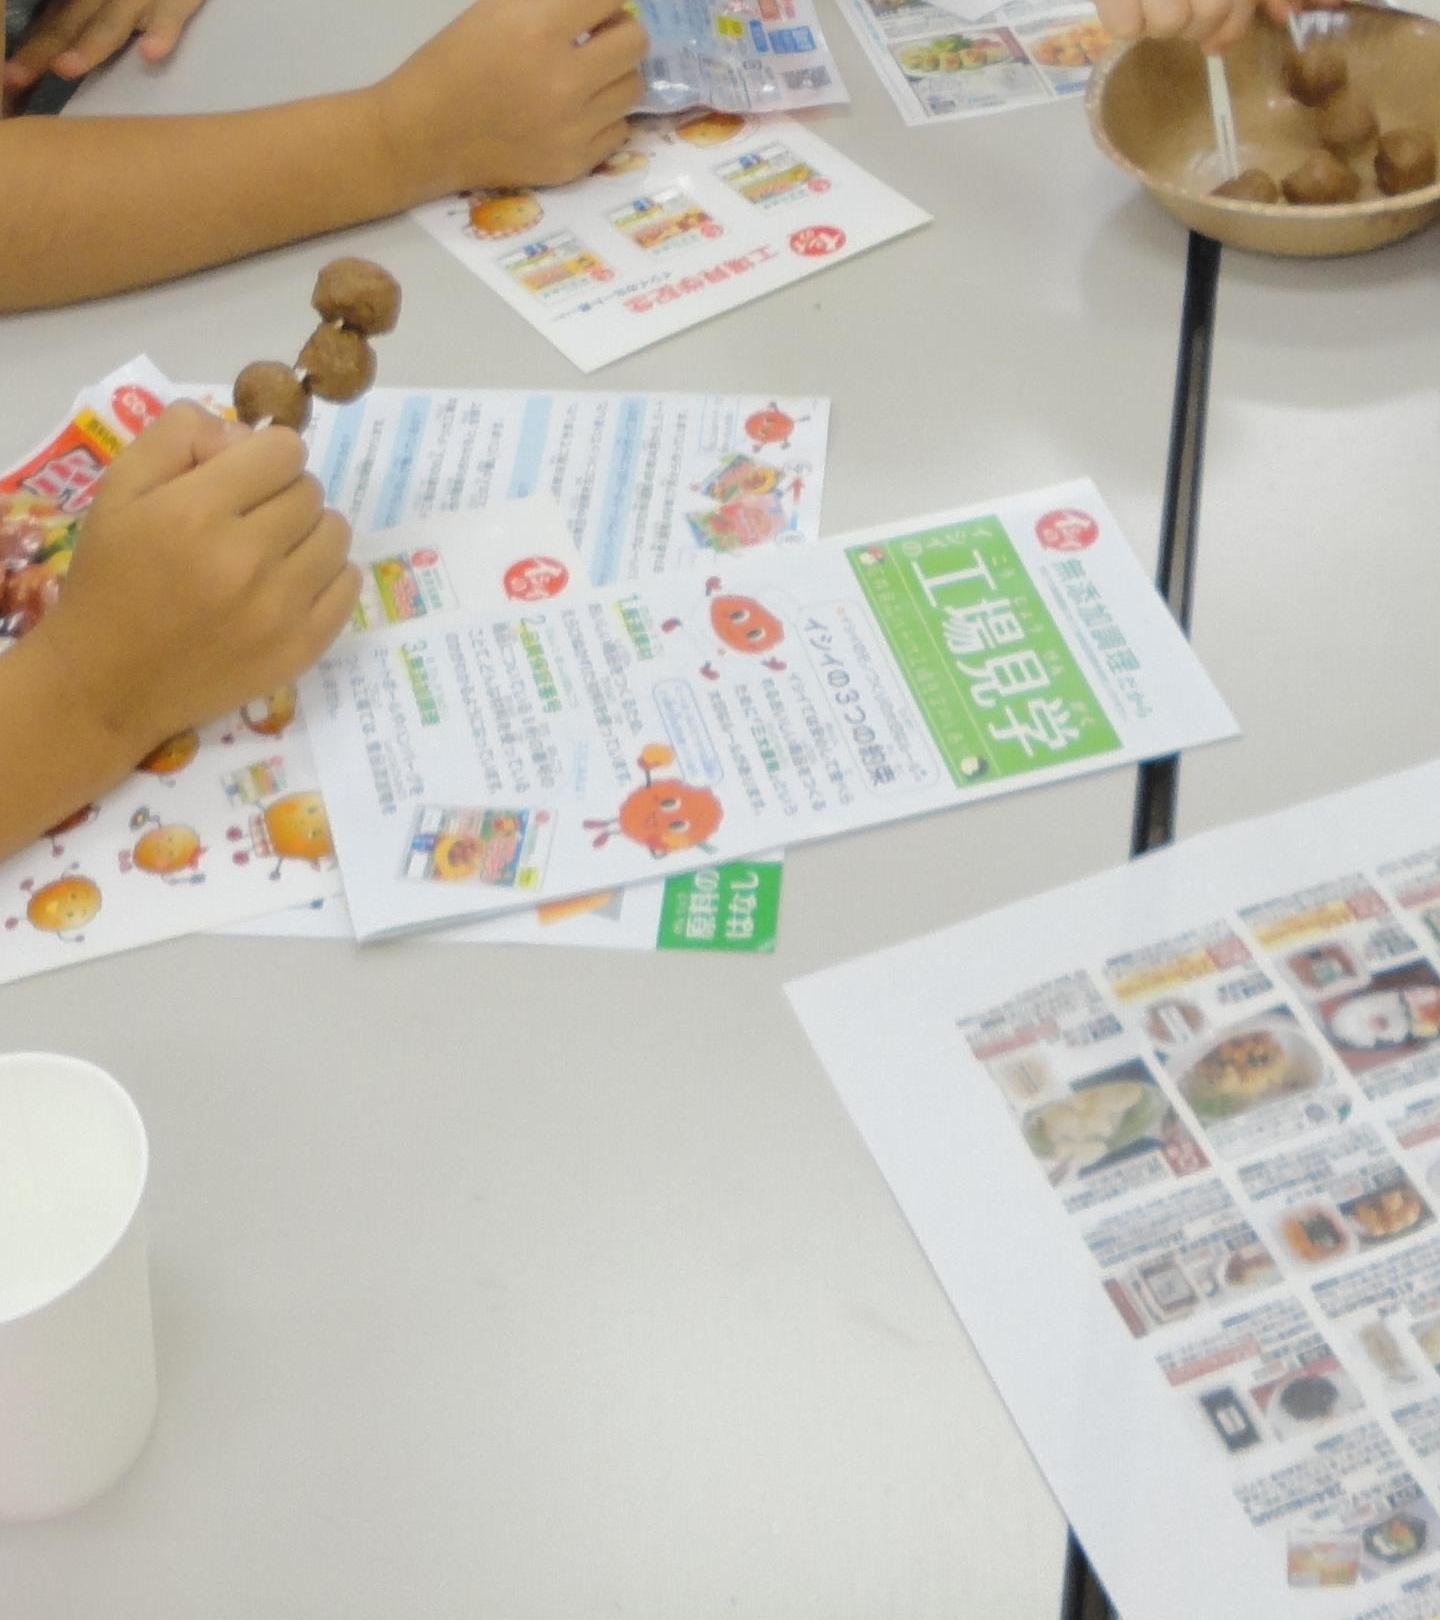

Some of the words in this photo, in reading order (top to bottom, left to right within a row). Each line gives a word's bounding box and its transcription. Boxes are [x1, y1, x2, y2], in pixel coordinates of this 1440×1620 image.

[804, 617, 896, 786] イシイの3つの約束
[912, 549, 1081, 757] 工場見学
[721, 874, 760, 939] はなし
